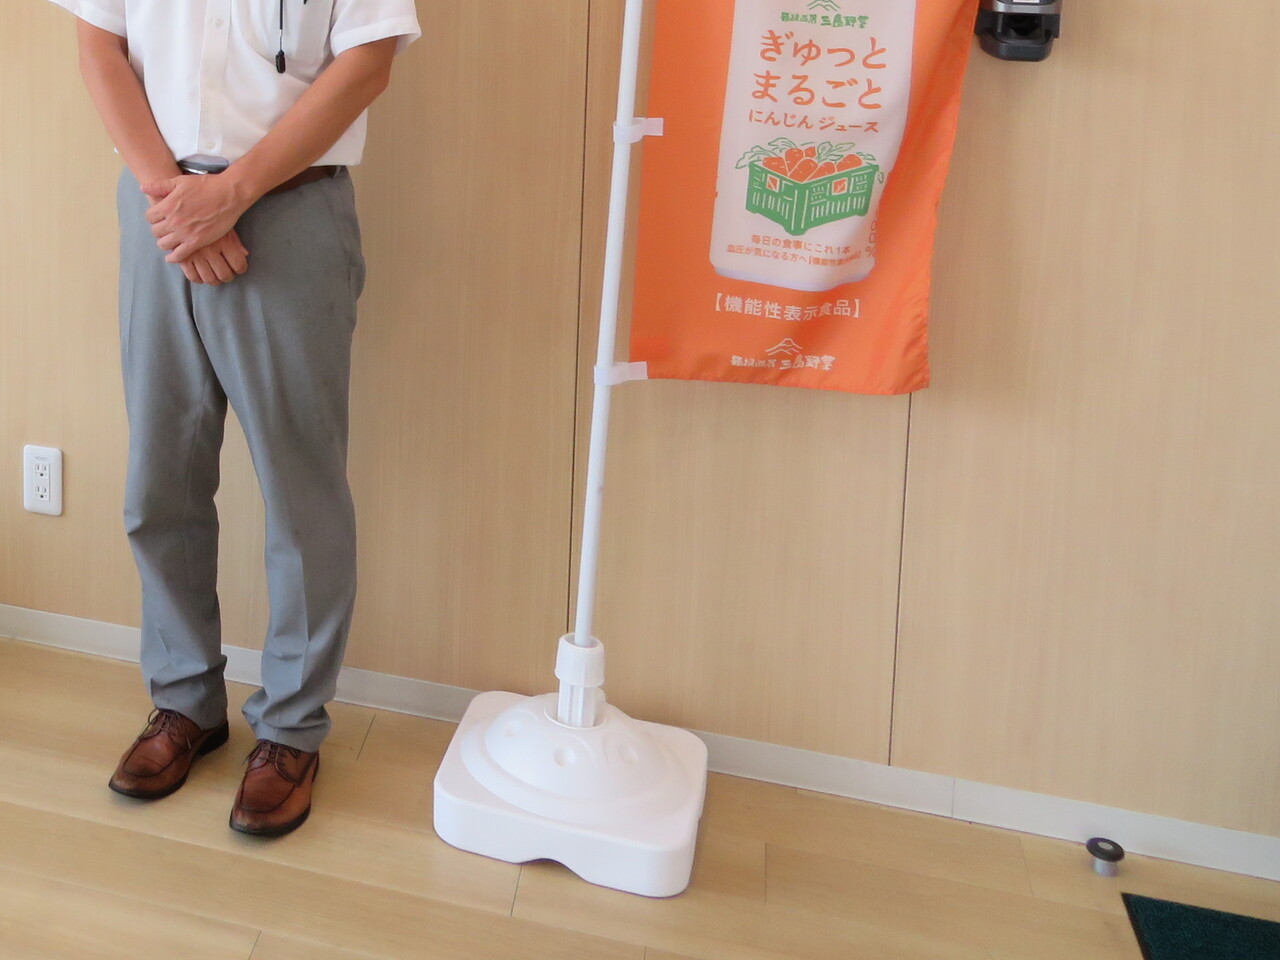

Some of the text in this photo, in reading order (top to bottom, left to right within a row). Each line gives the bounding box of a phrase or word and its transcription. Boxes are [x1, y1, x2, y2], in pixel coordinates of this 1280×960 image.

[759, 29, 887, 69] ぎゅっと
[751, 70, 882, 109] まるごと
